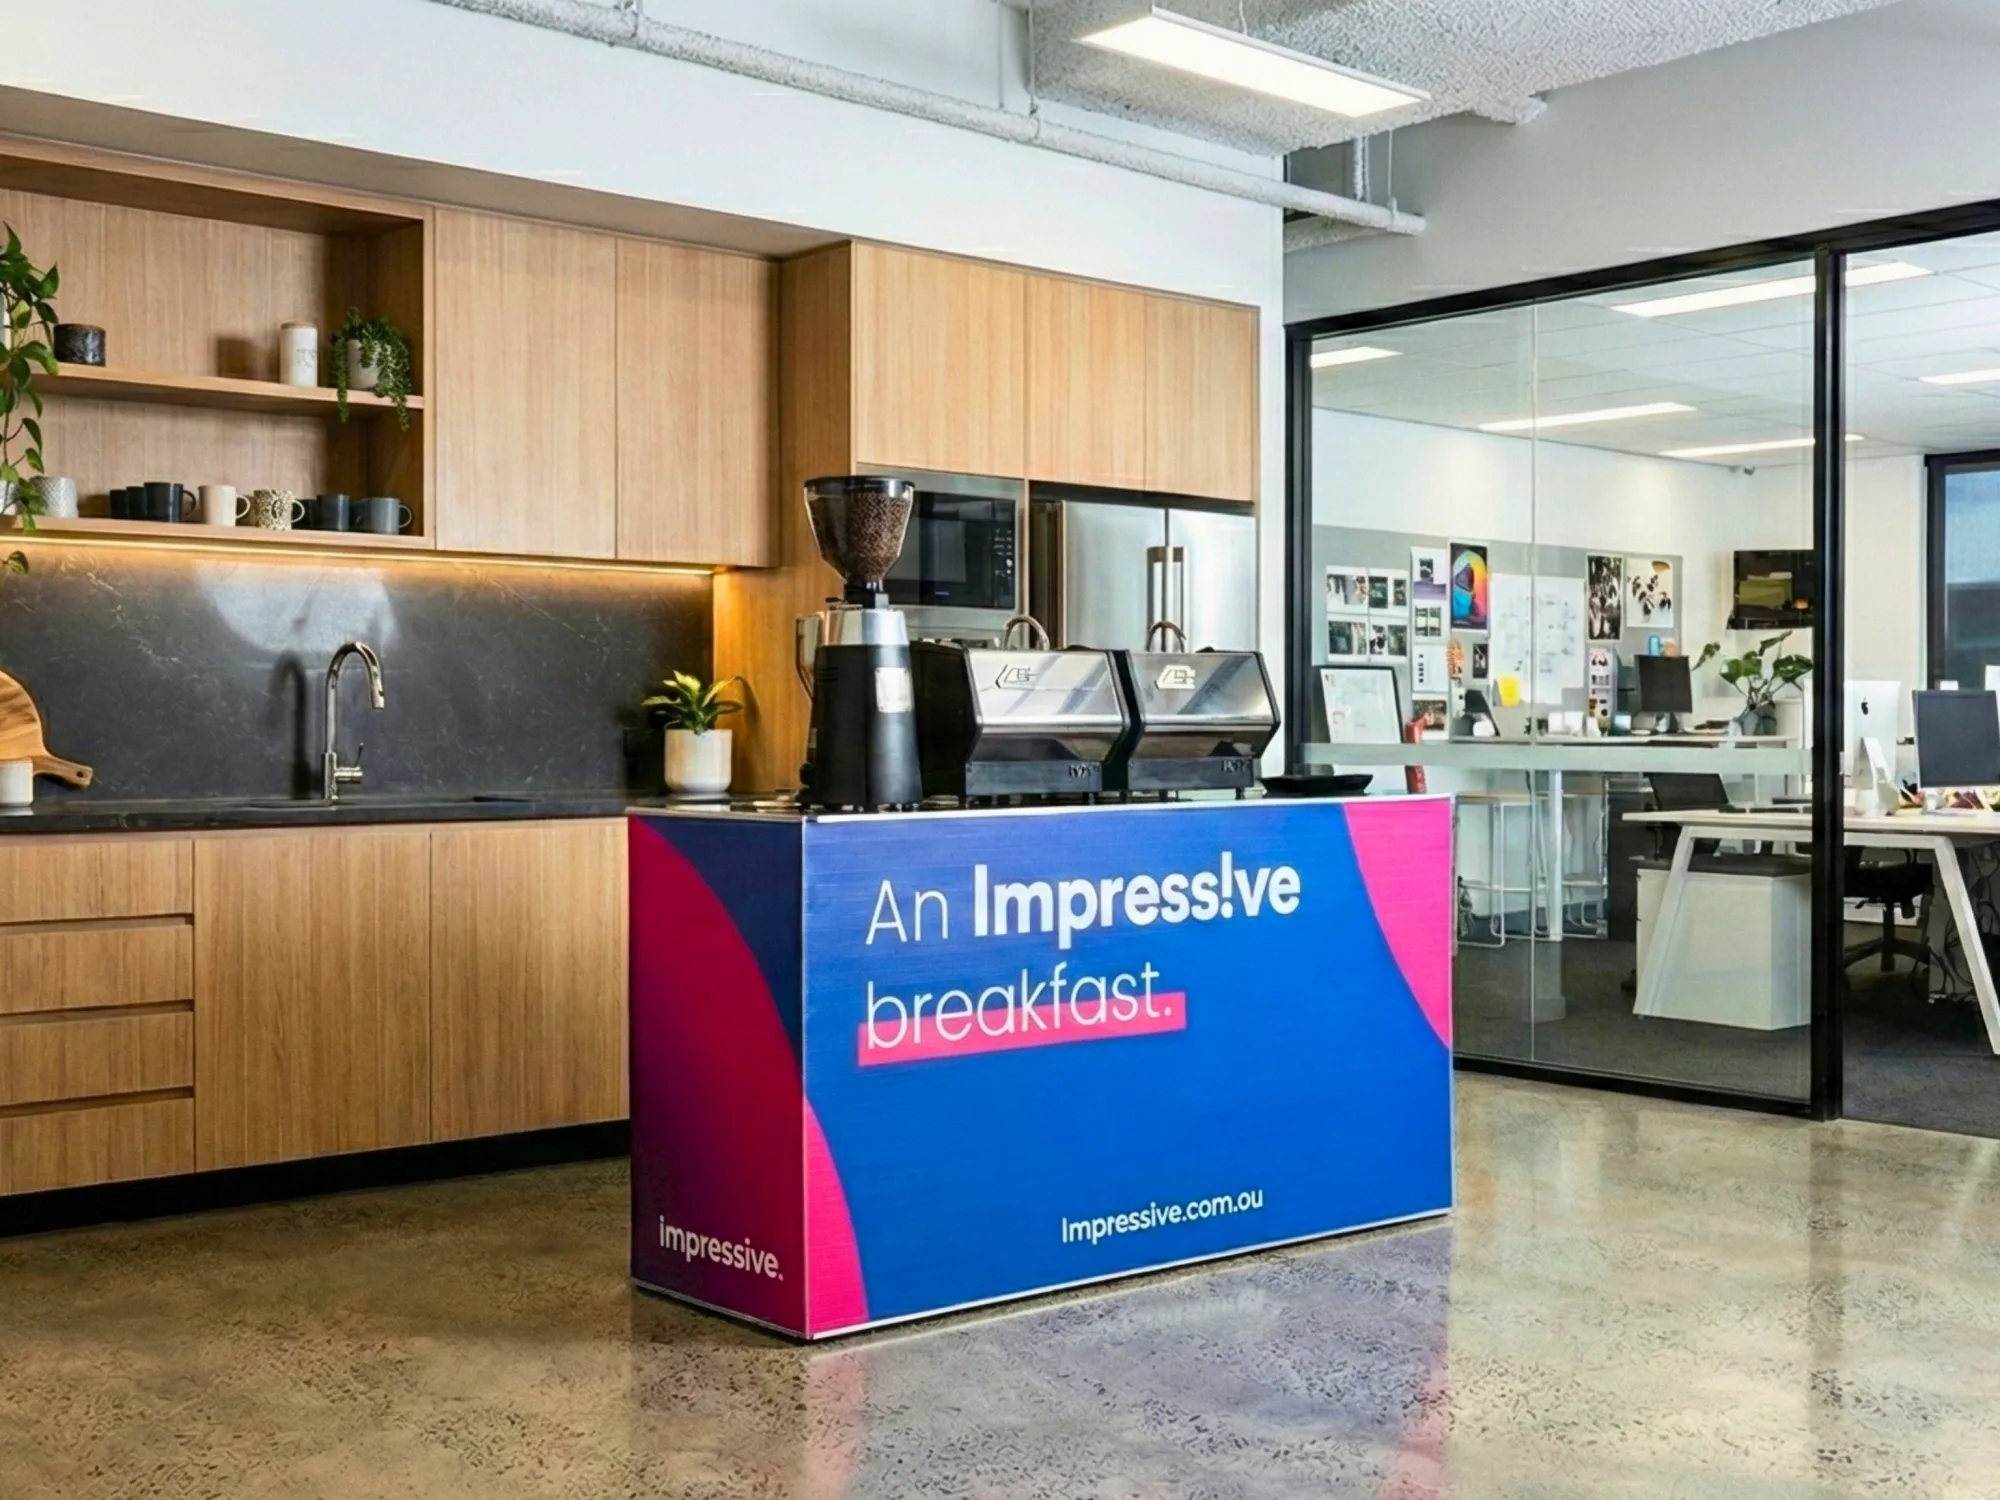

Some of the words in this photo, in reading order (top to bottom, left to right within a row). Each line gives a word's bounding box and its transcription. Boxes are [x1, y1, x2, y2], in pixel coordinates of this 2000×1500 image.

[866, 880, 949, 945] An
[973, 851, 1300, 949] Impress!ve
[867, 961, 1173, 1049] breakfast.
[659, 1215, 783, 1281] impressive.
